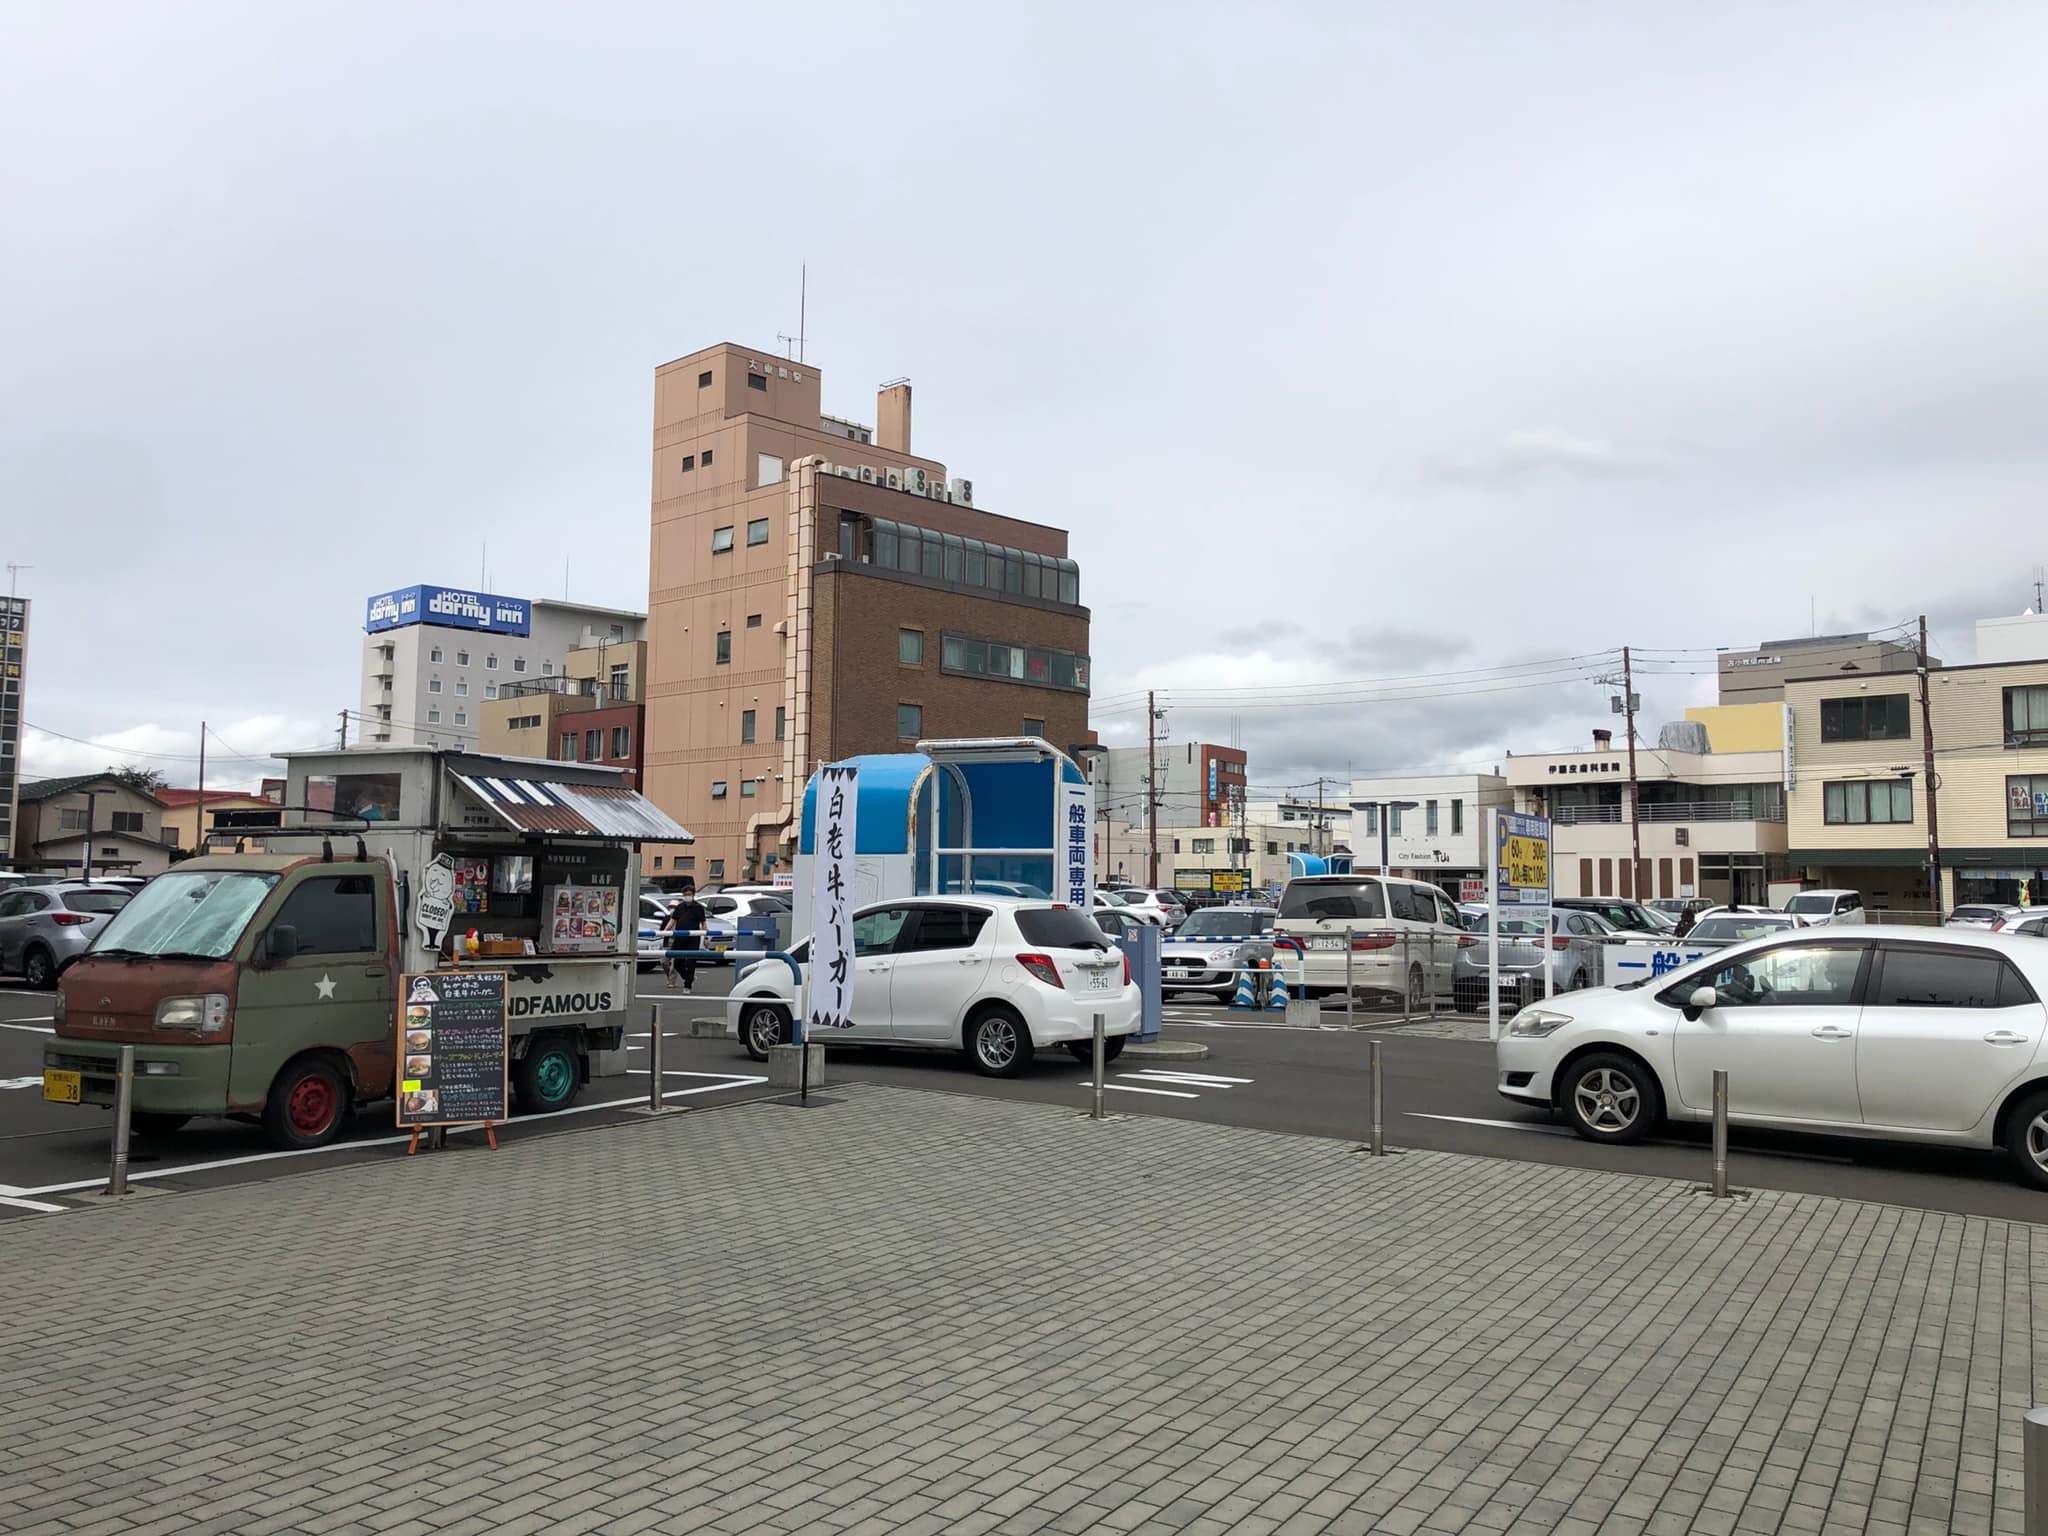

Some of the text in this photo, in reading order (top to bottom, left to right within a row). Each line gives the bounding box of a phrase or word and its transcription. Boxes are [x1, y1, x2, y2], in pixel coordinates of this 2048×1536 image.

[370, 599, 416, 622] dormy inn
[376, 595, 393, 608] HOTEL
[429, 593, 523, 626] dormy inn
[442, 591, 480, 606] HOTEL
[1068, 790, 1086, 907] 一般車両専用
[826, 786, 850, 1011] 白老牛バーガー
